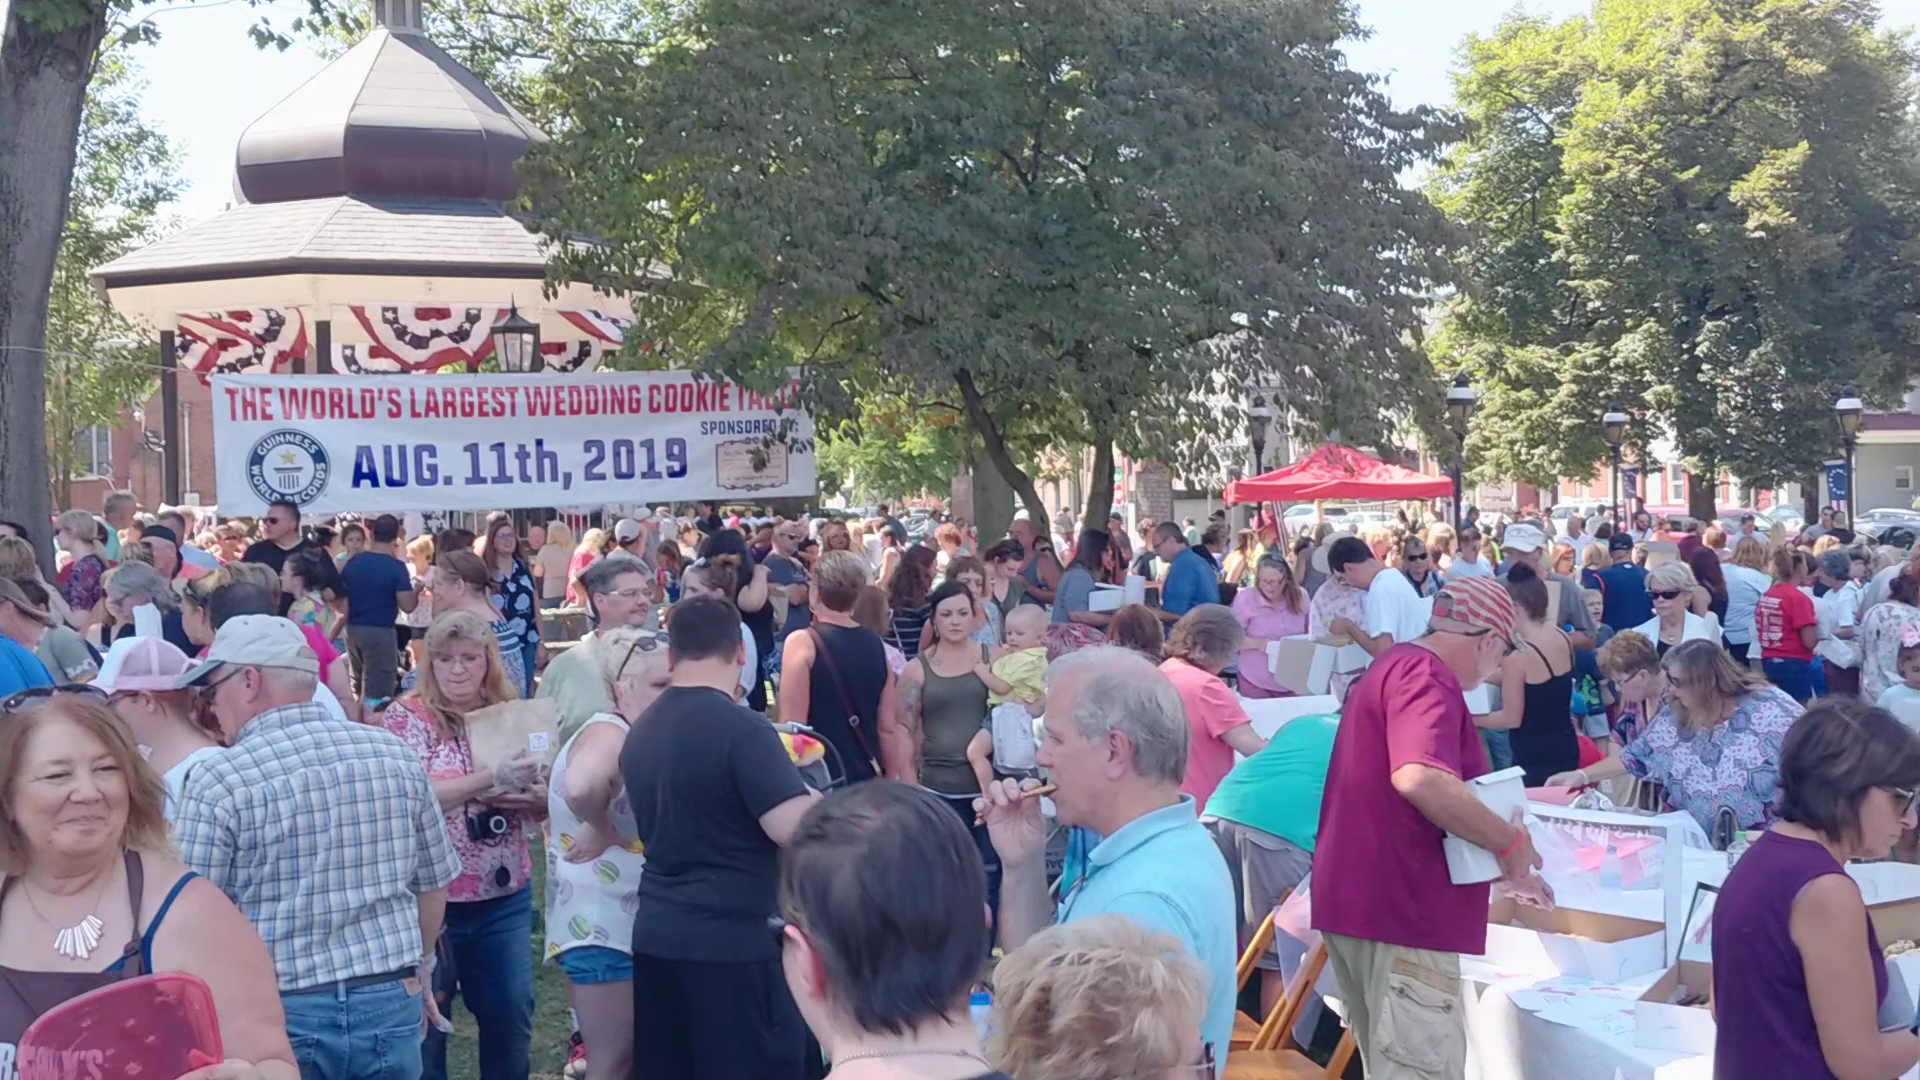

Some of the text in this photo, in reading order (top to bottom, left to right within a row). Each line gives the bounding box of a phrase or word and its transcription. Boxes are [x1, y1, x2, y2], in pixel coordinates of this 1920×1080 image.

[224, 386, 274, 421] THE
[278, 386, 403, 421] WORLD'S
[410, 386, 519, 418] LARGEST
[524, 384, 642, 417] WEDDING
[648, 382, 731, 414] COOKIE
[257, 433, 319, 456] GUINNESS
[700, 419, 777, 436] SPONSORED
[351, 437, 688, 490] AUG. 11th, 2019
[250, 464, 282, 501] WORLD
